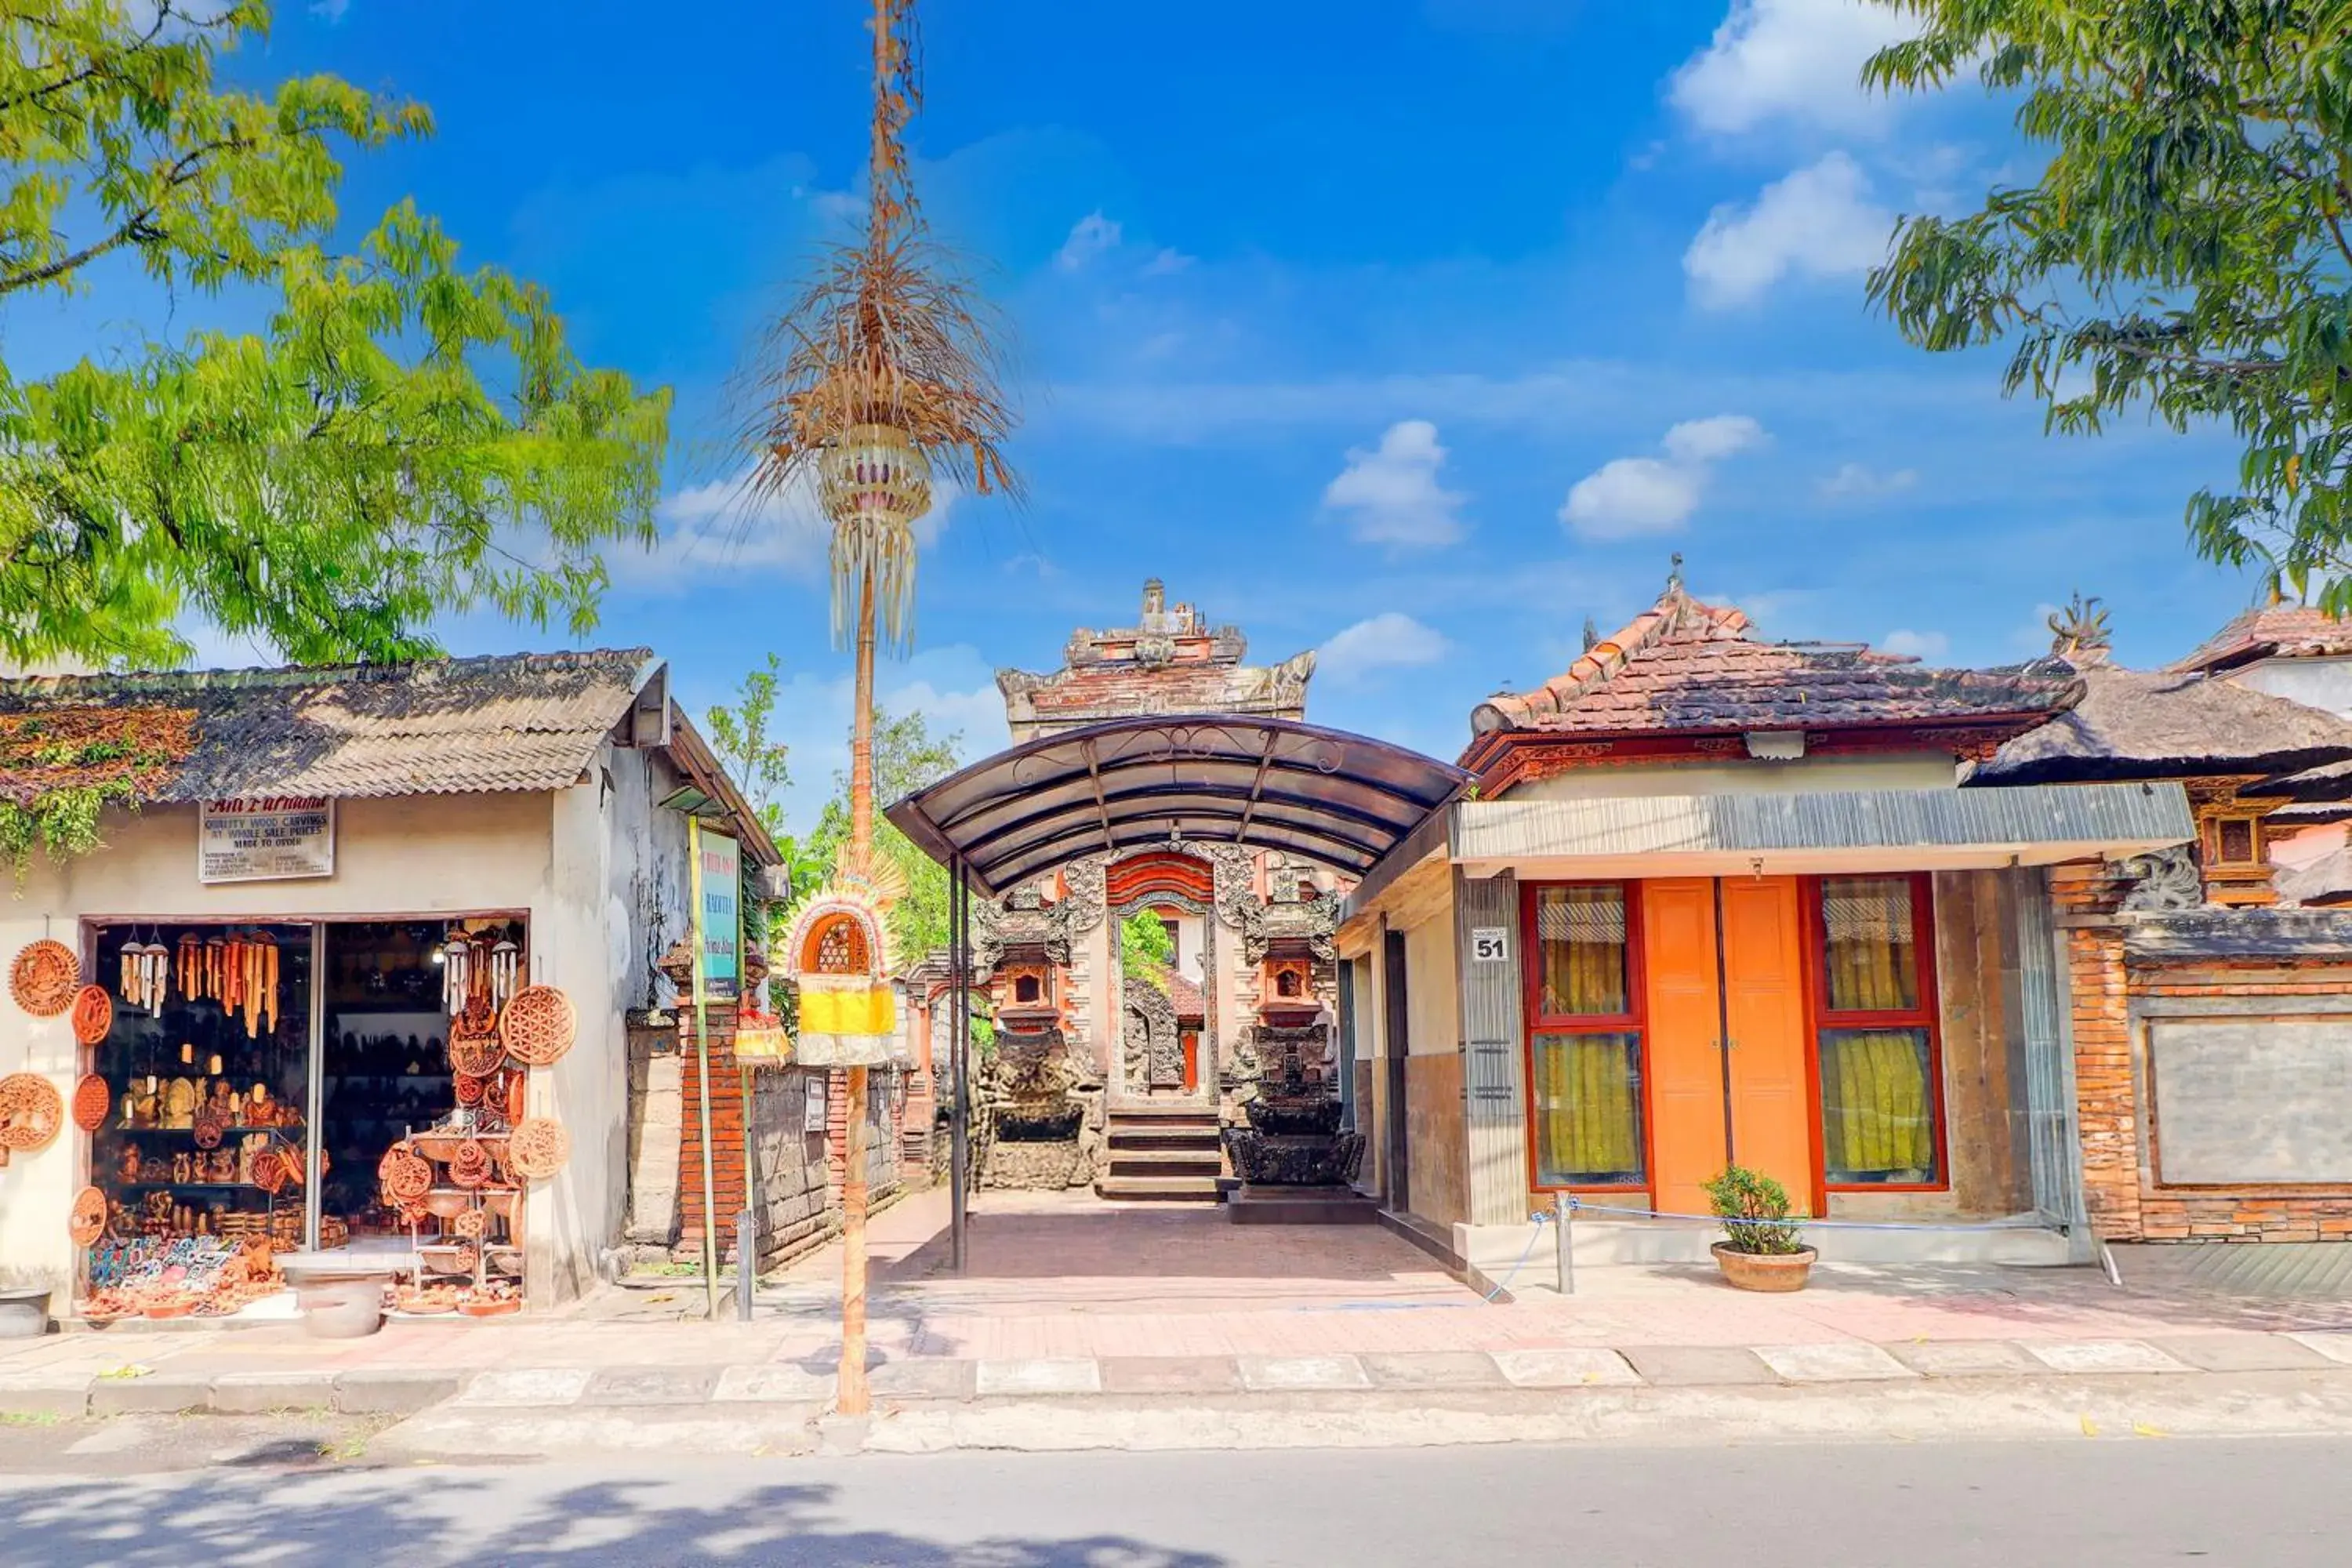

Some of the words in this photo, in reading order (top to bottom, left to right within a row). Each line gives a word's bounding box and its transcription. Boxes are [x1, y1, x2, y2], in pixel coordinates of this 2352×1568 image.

[205, 818, 245, 830] QUALITY
[251, 816, 278, 828] WOOD
[282, 815, 327, 827] CARVINGS
[212, 829, 222, 839] AT
[228, 829, 260, 840] WHOLE
[264, 828, 288, 838] SALE
[290, 826, 321, 837] PRICES
[234, 839, 256, 848] MADE
[262, 838, 272, 848] TO
[276, 837, 302, 847] ORDER
[1478, 940, 1503, 957] 51
